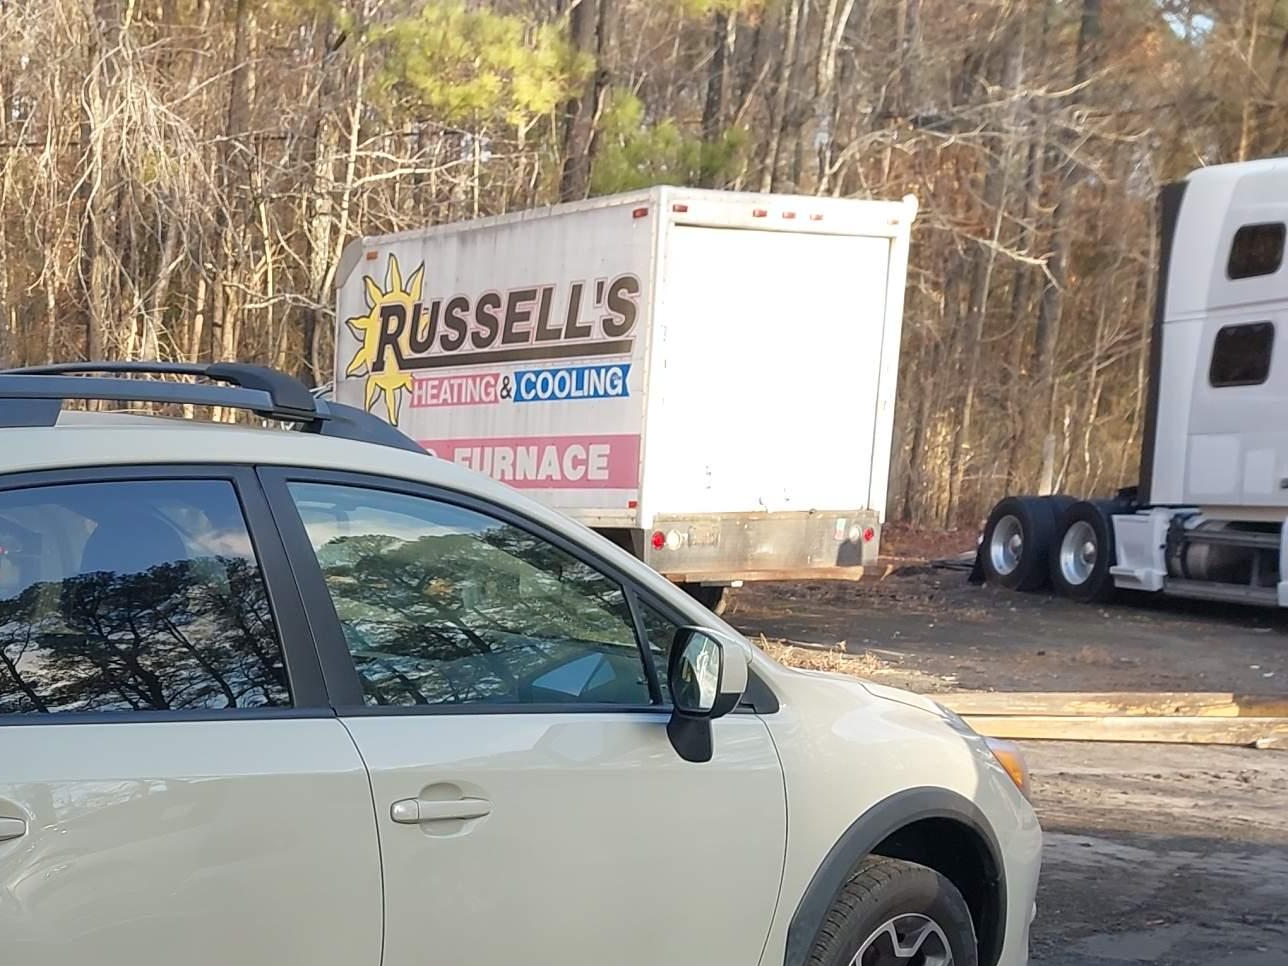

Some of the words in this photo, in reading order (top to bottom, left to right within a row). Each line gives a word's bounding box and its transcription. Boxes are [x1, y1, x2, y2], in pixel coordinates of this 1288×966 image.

[371, 275, 641, 373] RUSSELL'S
[412, 377, 497, 405] HEATING
[499, 375, 513, 400] &
[519, 367, 623, 400] COOLING
